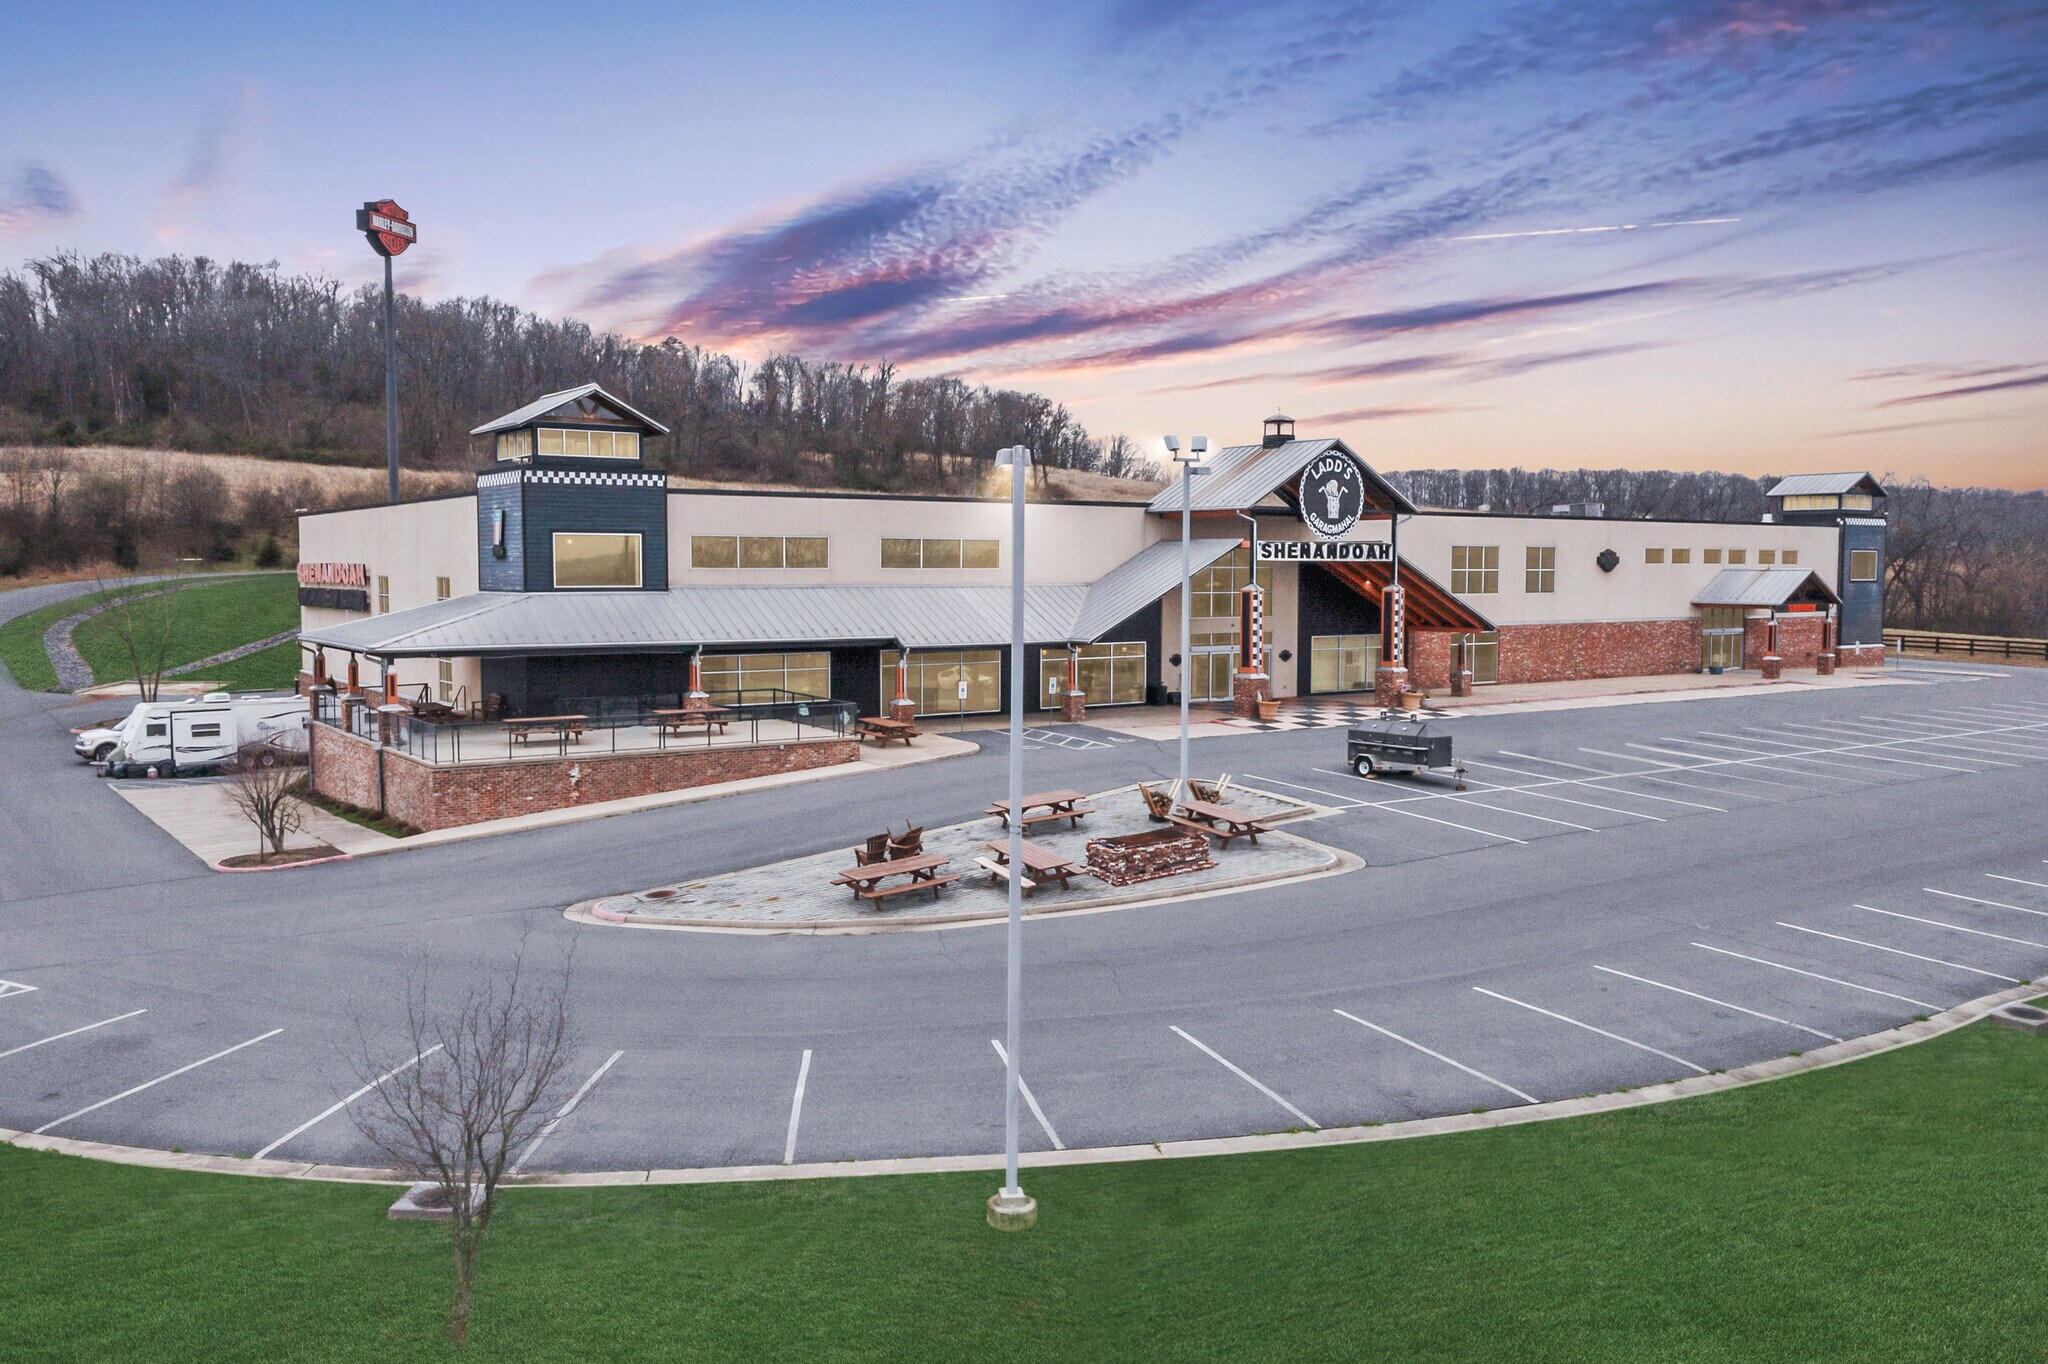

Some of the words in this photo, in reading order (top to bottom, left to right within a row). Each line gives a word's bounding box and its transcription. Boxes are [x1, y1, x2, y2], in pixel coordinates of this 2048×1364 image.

[1311, 458, 1353, 480] LADD'S
[1309, 512, 1355, 534] GARAGMAHAL
[1261, 542, 1393, 560] SHENANDOAH
[297, 562, 366, 586] SHENANDOAH
